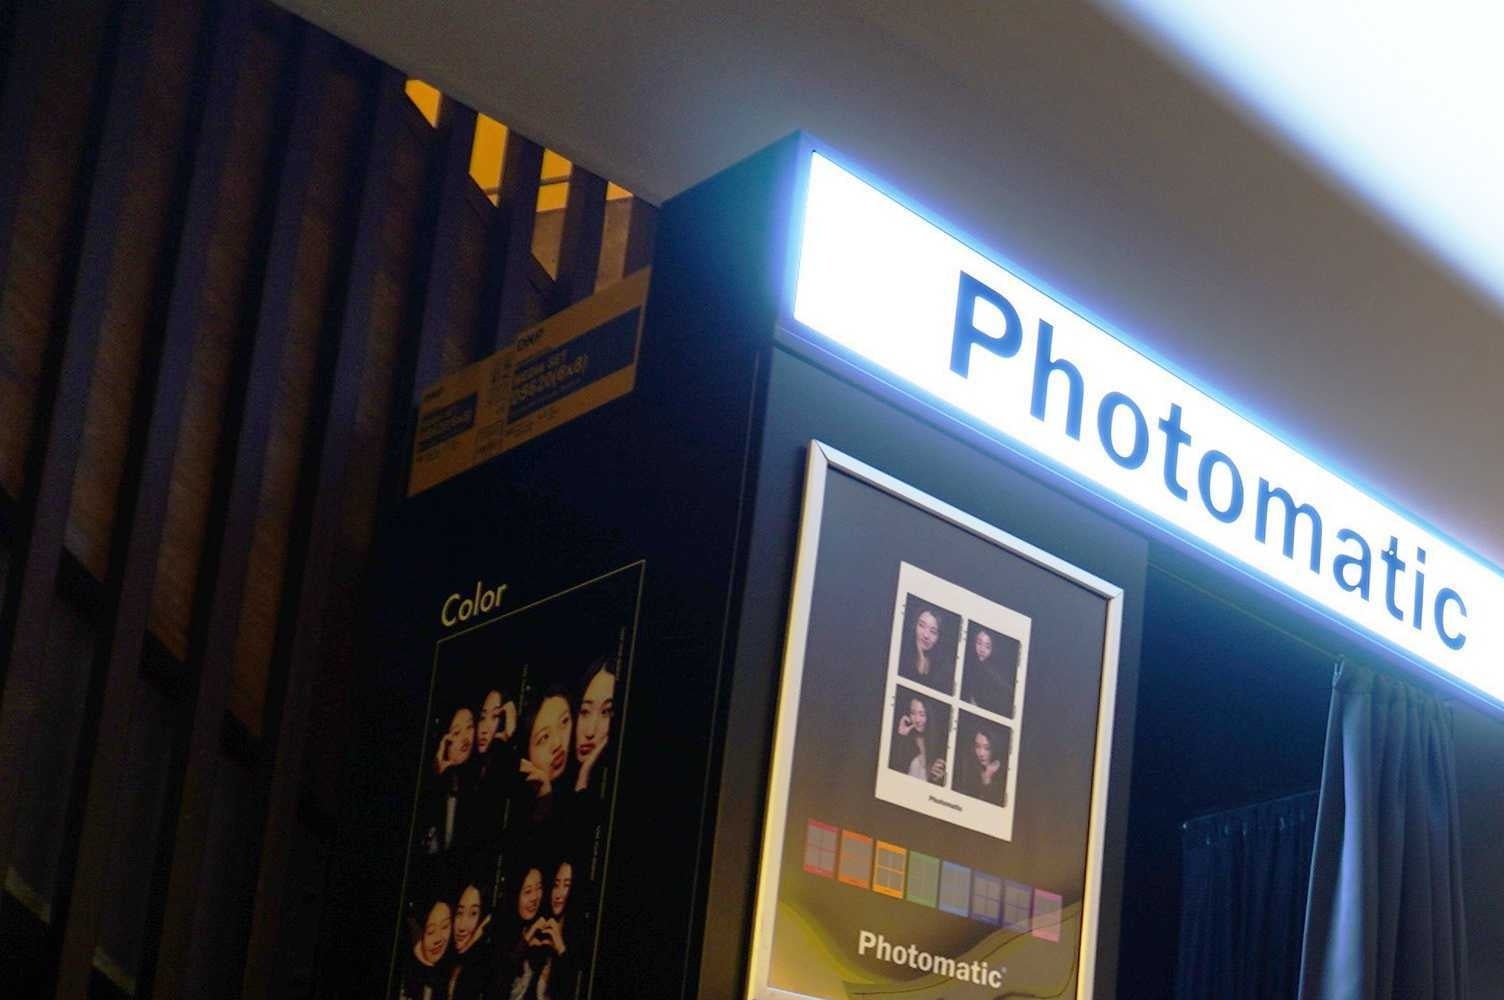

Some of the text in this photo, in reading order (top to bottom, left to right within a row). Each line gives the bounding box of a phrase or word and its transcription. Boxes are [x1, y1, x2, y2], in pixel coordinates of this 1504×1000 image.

[948, 269, 1469, 652] Photomatic
[441, 580, 508, 630] Color
[858, 930, 1003, 989] Photomatic
